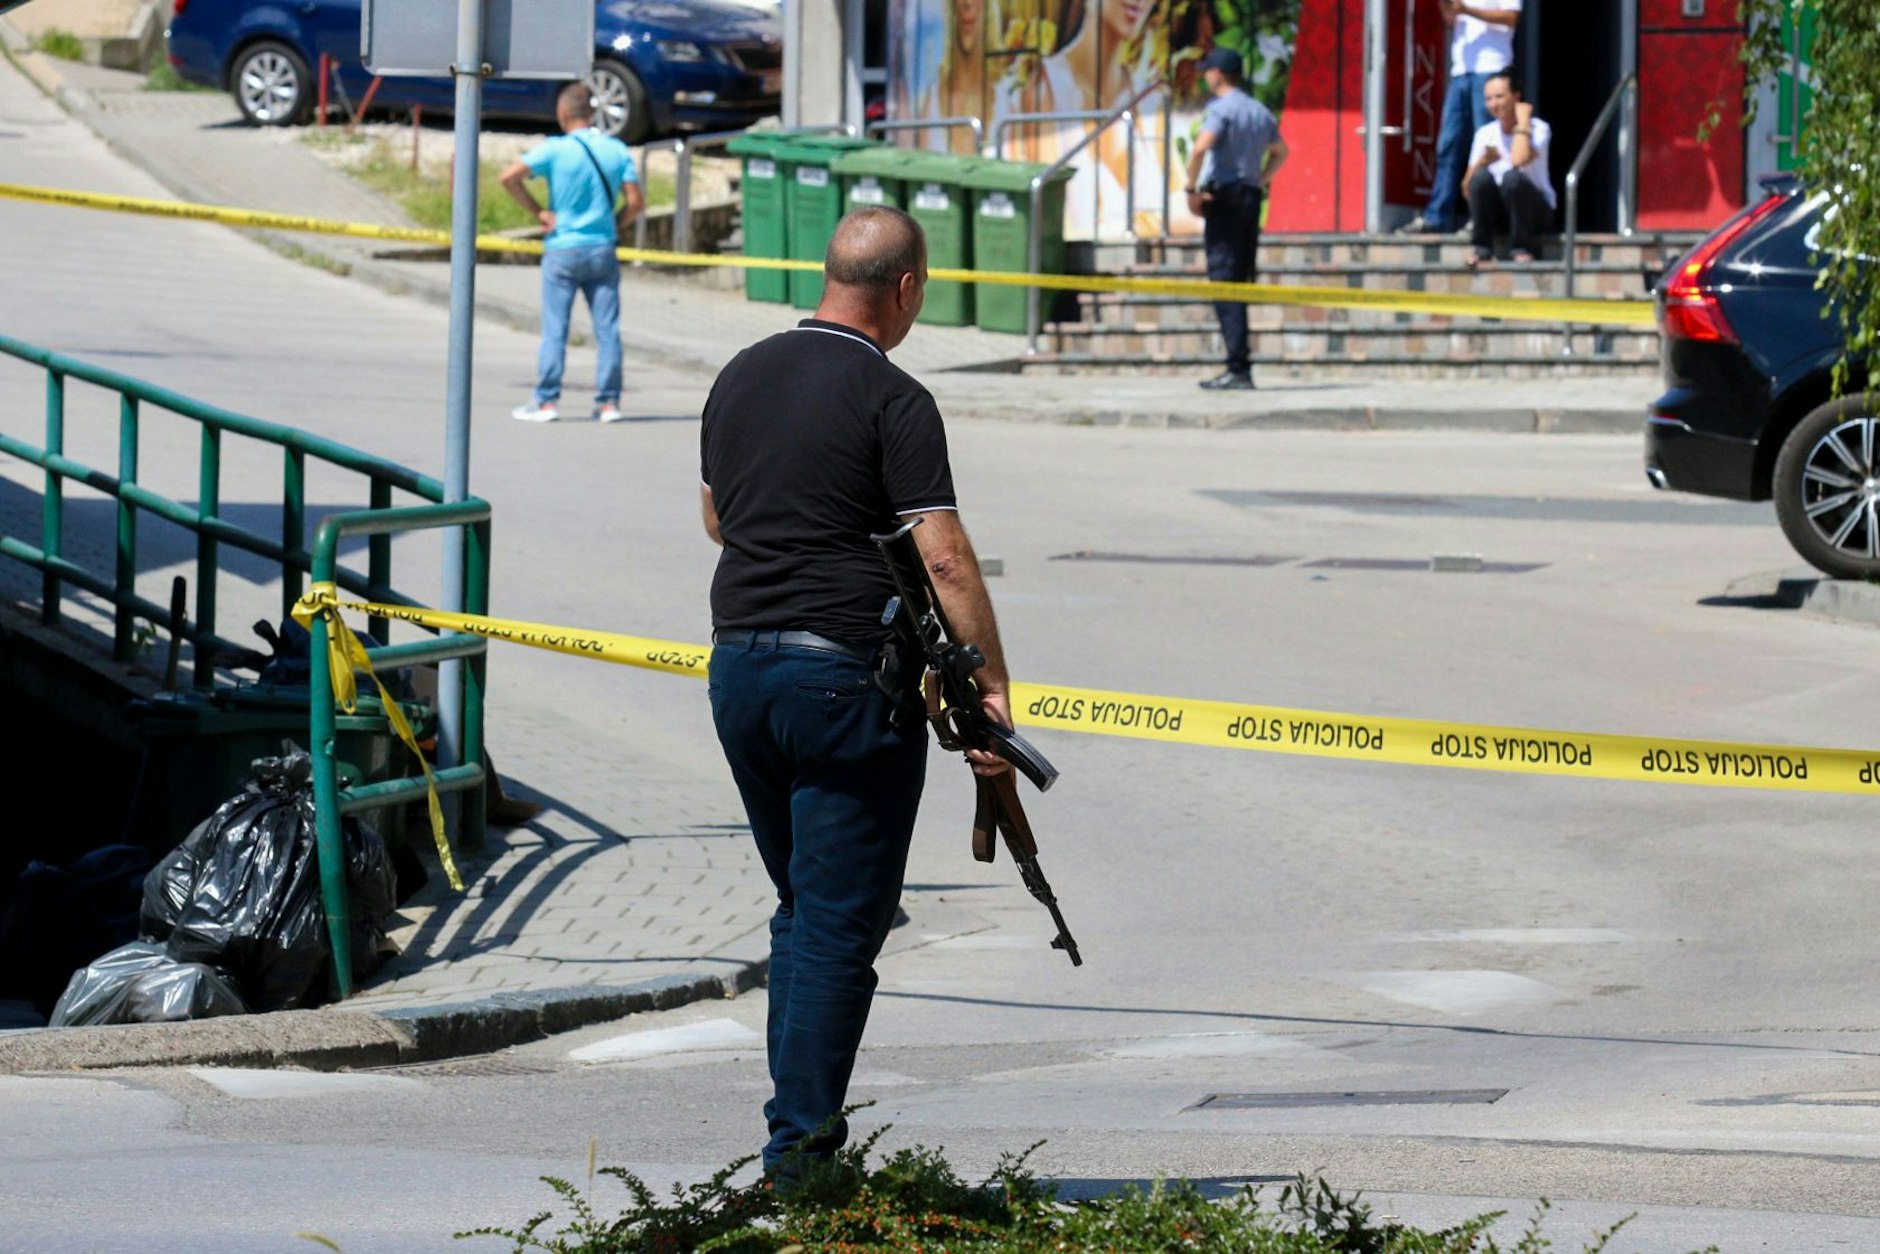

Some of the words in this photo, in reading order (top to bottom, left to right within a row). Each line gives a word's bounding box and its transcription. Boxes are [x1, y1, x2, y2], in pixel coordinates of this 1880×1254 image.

[1413, 43, 1436, 195] IZLAZ
[1028, 695, 1085, 720] STOP
[1091, 701, 1184, 731] POLICIJA
[1227, 716, 1283, 742] STOP
[1289, 720, 1384, 750] POLICIJA
[1431, 733, 1487, 759] STOP
[1492, 737, 1592, 766] POLICIJA
[1641, 748, 1700, 774] STOP
[1704, 752, 1808, 779] POLICIJA
